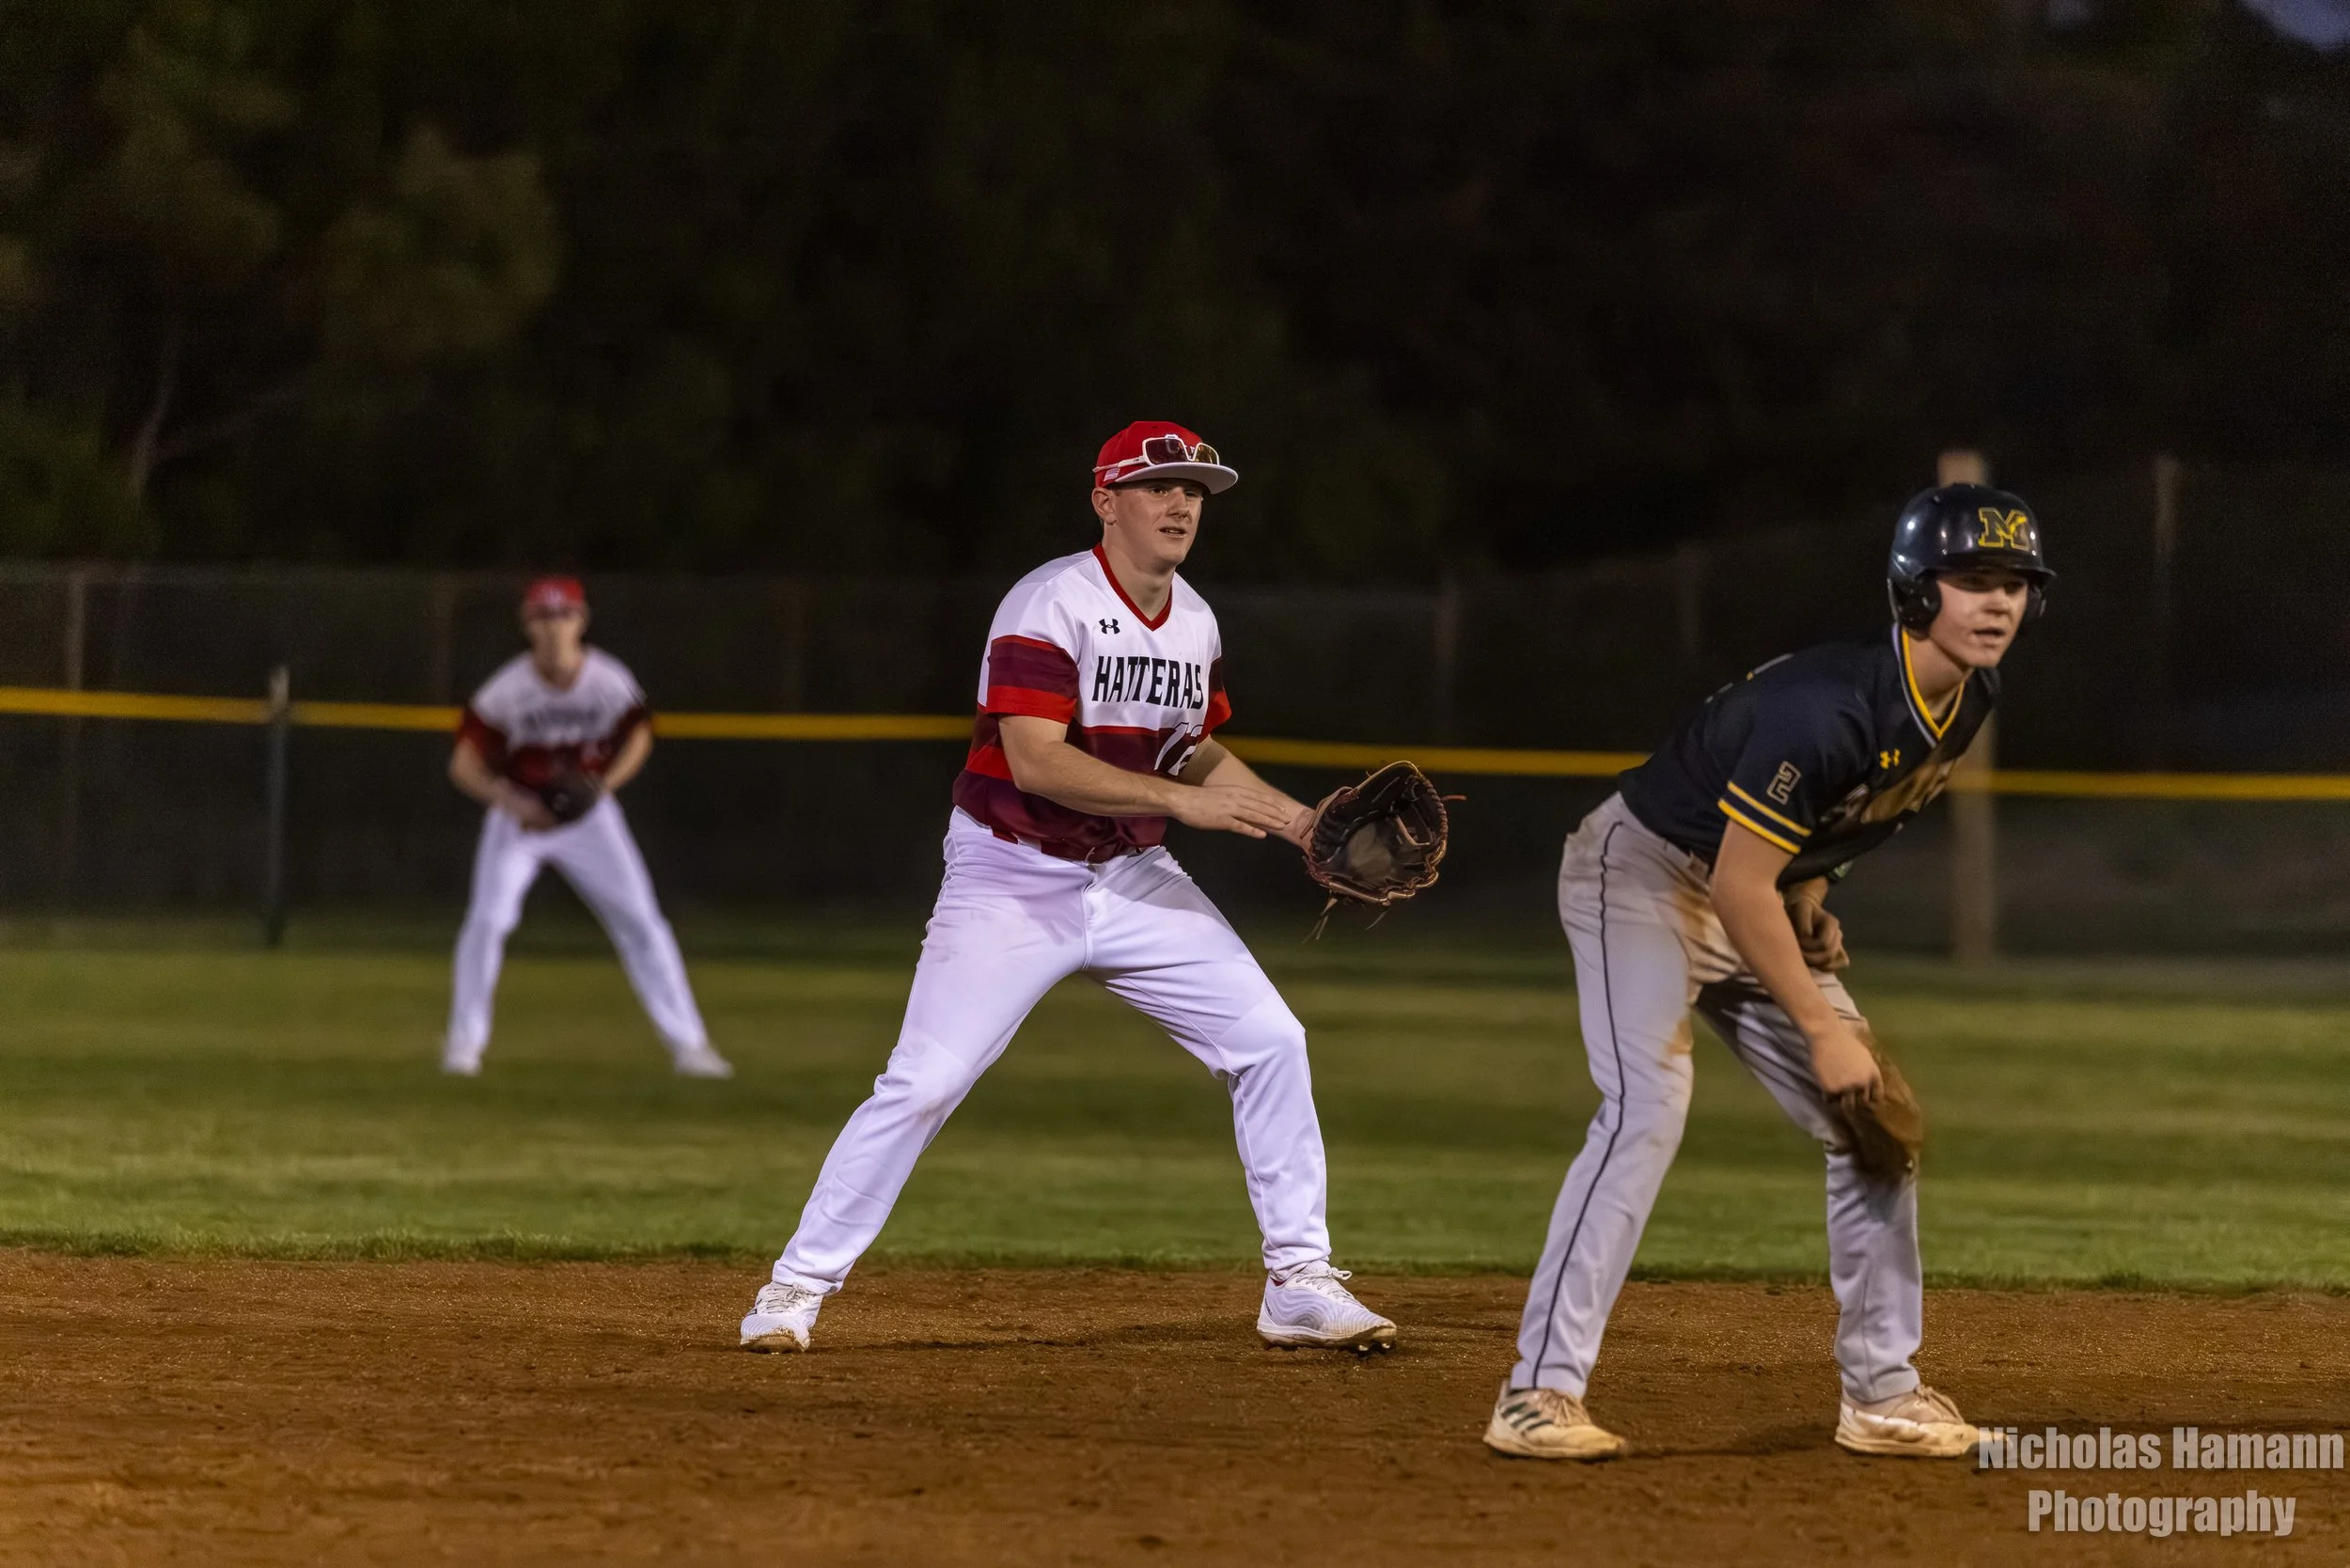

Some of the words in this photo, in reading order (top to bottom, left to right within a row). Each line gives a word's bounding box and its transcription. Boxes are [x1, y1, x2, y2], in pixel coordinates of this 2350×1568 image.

[1978, 507, 2029, 552] M
[1091, 655, 1204, 710] HATTERAS
[1766, 760, 1802, 806] 2
